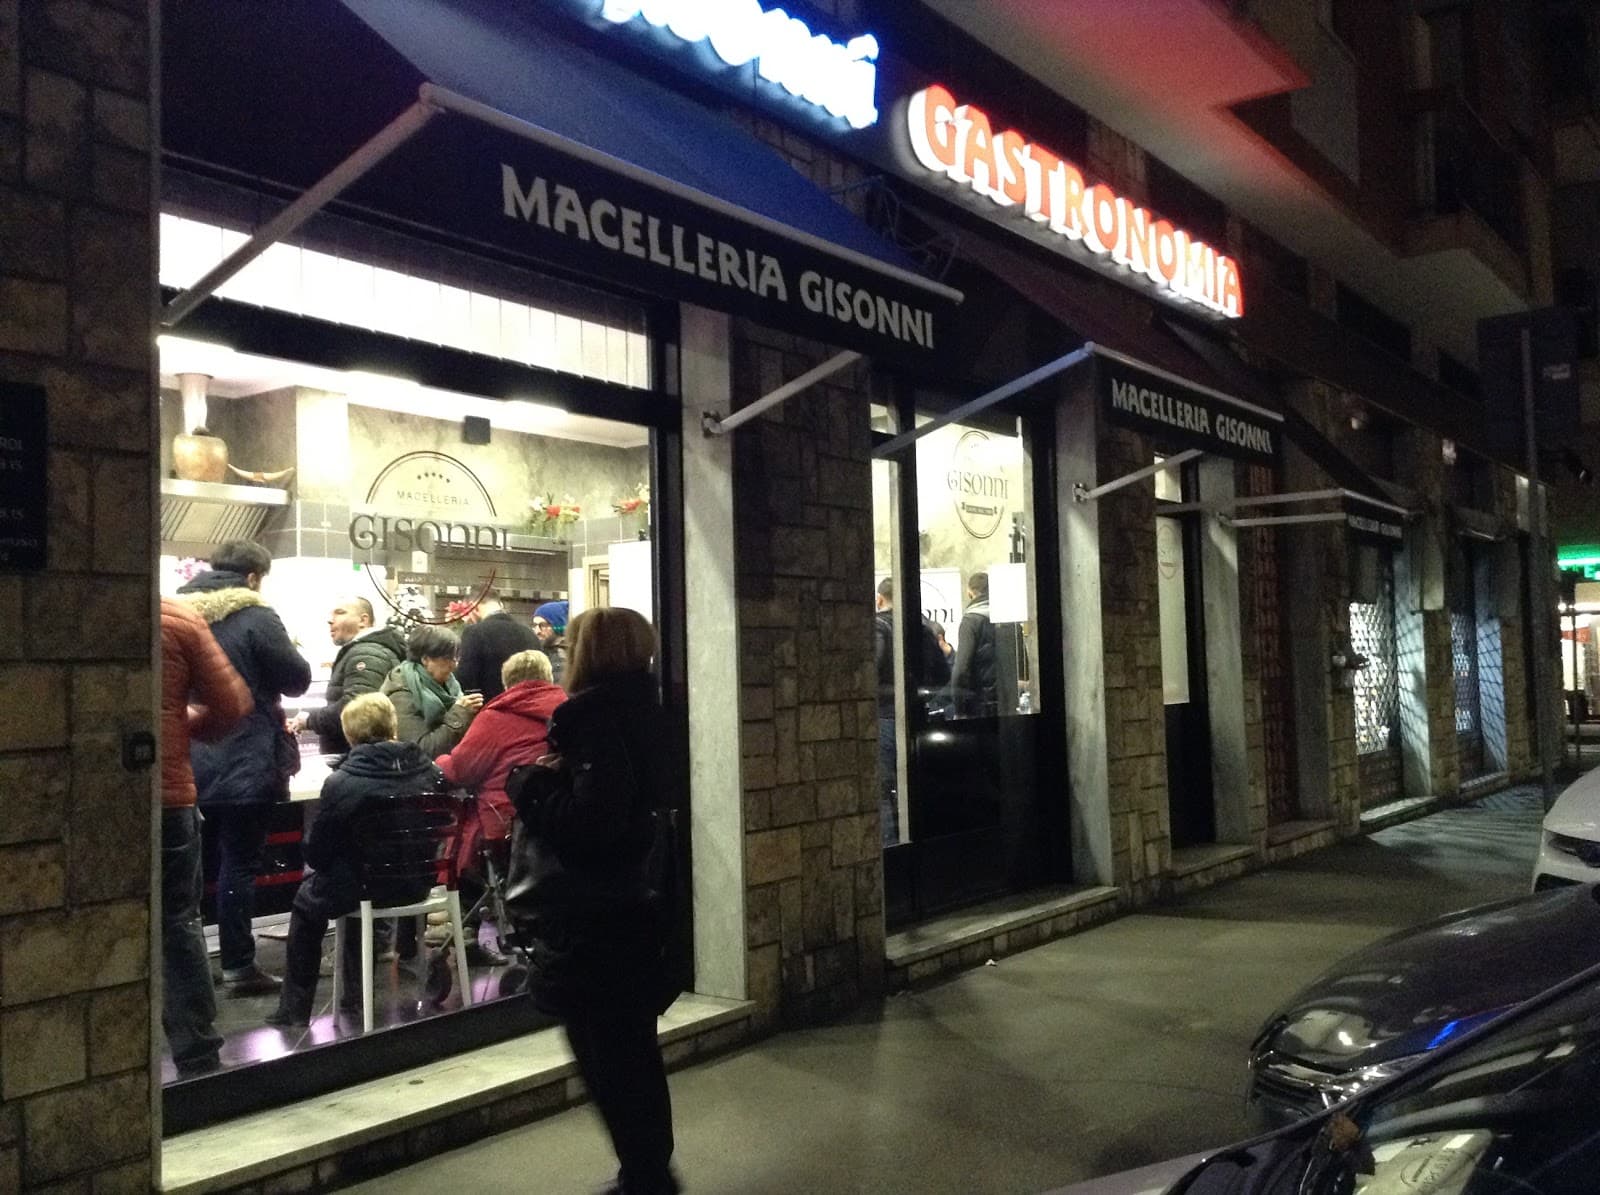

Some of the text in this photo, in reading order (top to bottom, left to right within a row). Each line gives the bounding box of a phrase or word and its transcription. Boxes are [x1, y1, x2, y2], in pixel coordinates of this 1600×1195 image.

[501, 163, 935, 349] MACELLERIA GISONNI
[908, 84, 1243, 318] GASTRONOMIA
[1111, 378, 1273, 454] MACELLERIA GISONNI
[397, 490, 470, 506] MACELLERIA
